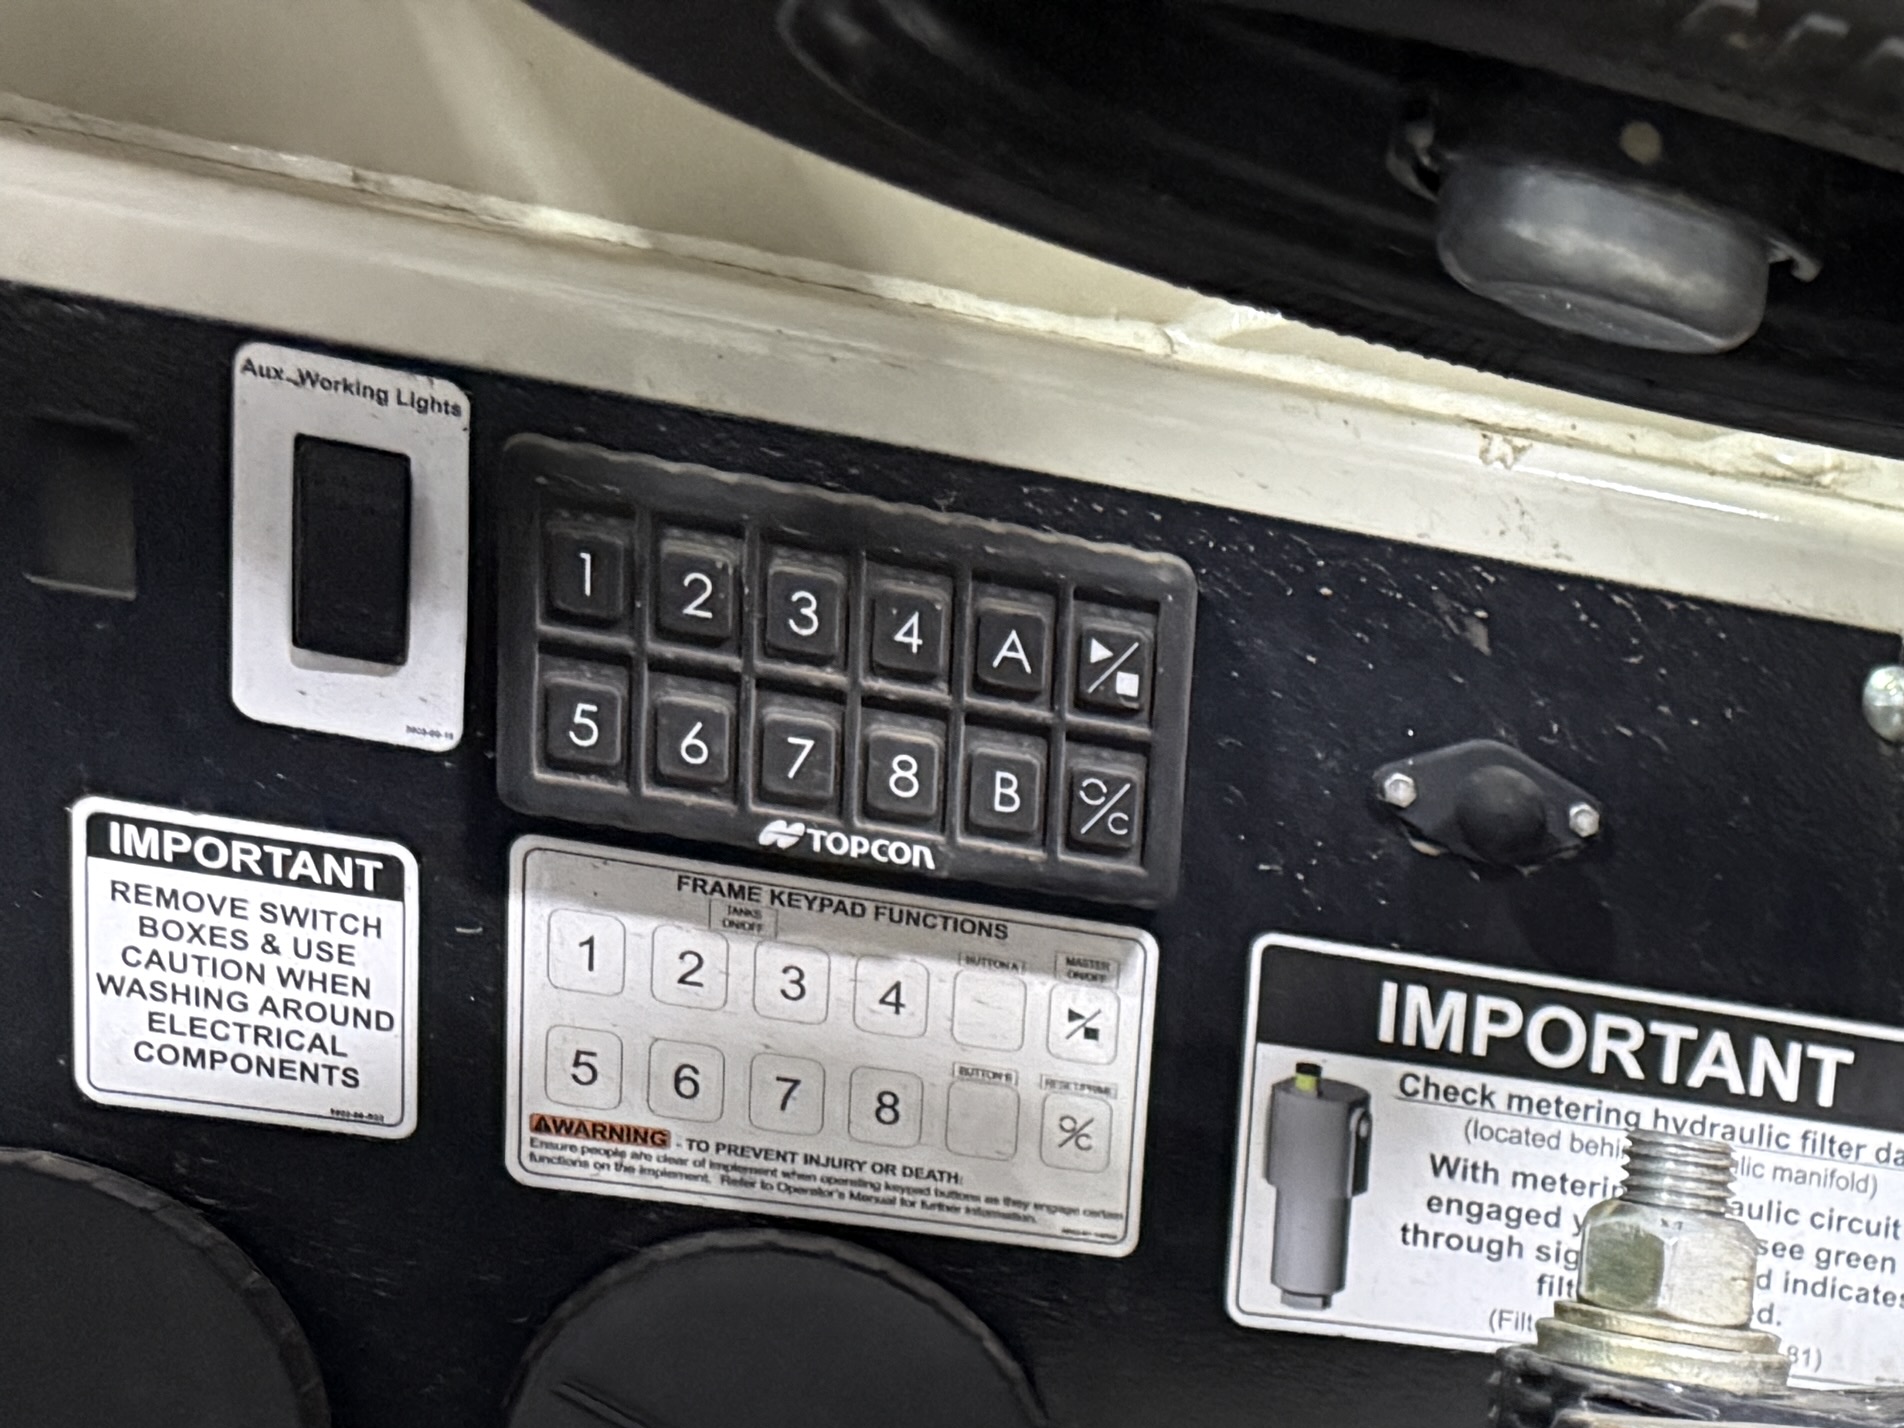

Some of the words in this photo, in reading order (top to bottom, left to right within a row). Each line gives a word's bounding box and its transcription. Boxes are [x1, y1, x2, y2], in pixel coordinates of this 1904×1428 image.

[298, 367, 389, 406] Working
[396, 388, 462, 417] Lights
[577, 550, 593, 597] 1
[681, 573, 714, 619] 2
[786, 591, 820, 636] 3
[894, 611, 925, 655] 4
[991, 630, 1033, 675] A
[568, 703, 600, 748] 5
[679, 722, 710, 765] 6
[786, 737, 816, 780] 7
[888, 755, 921, 799] 8
[992, 771, 1022, 814] B
[109, 821, 384, 892] IMPORTANT
[811, 830, 937, 871] TOPCON
[110, 880, 249, 920] REMOVE
[259, 901, 382, 938] SWITCH
[677, 874, 763, 903] FRAME
[769, 888, 866, 919] KEYPAD
[873, 907, 1009, 941] FUNCTIONS
[121, 946, 265, 985] CAUTION
[276, 965, 371, 1000] WHEN
[138, 916, 249, 950] BOXES
[261, 933, 282, 956] &
[293, 938, 356, 966] USE
[96, 972, 249, 1013] WASHING
[258, 996, 395, 1033] AROUND
[578, 934, 596, 973] 1
[677, 950, 705, 988] 2
[779, 965, 807, 1002] 3
[878, 980, 907, 1016] 4
[133, 1041, 360, 1089] COMPONENTS
[148, 1011, 348, 1058] ELECTRICAL
[1376, 979, 1856, 1109] IMPORTANT
[570, 1049, 599, 1086] 5
[673, 1063, 701, 1100] 6
[775, 1075, 802, 1112] 7
[875, 1091, 901, 1126] 8
[1398, 1072, 1498, 1109] Check
[1507, 1091, 1642, 1132] metering
[1800, 1129, 1868, 1162] filter
[552, 1116, 669, 1147] WARNING
[686, 1138, 710, 1151] TO
[715, 1142, 799, 1165] PREVENT
[803, 1153, 867, 1173] INJURY
[871, 1161, 898, 1176] OR
[580, 1144, 627, 1162] people
[1464, 1117, 1563, 1151] (located
[1569, 1133, 1630, 1160] behi
[1771, 1164, 1879, 1201] manifold)
[1430, 1152, 1501, 1187] With
[1809, 1207, 1902, 1241] circuit
[1400, 1222, 1525, 1264] through
[1426, 1194, 1563, 1230] engaged
[1757, 1239, 1806, 1262] see
[1814, 1246, 1898, 1276] green
